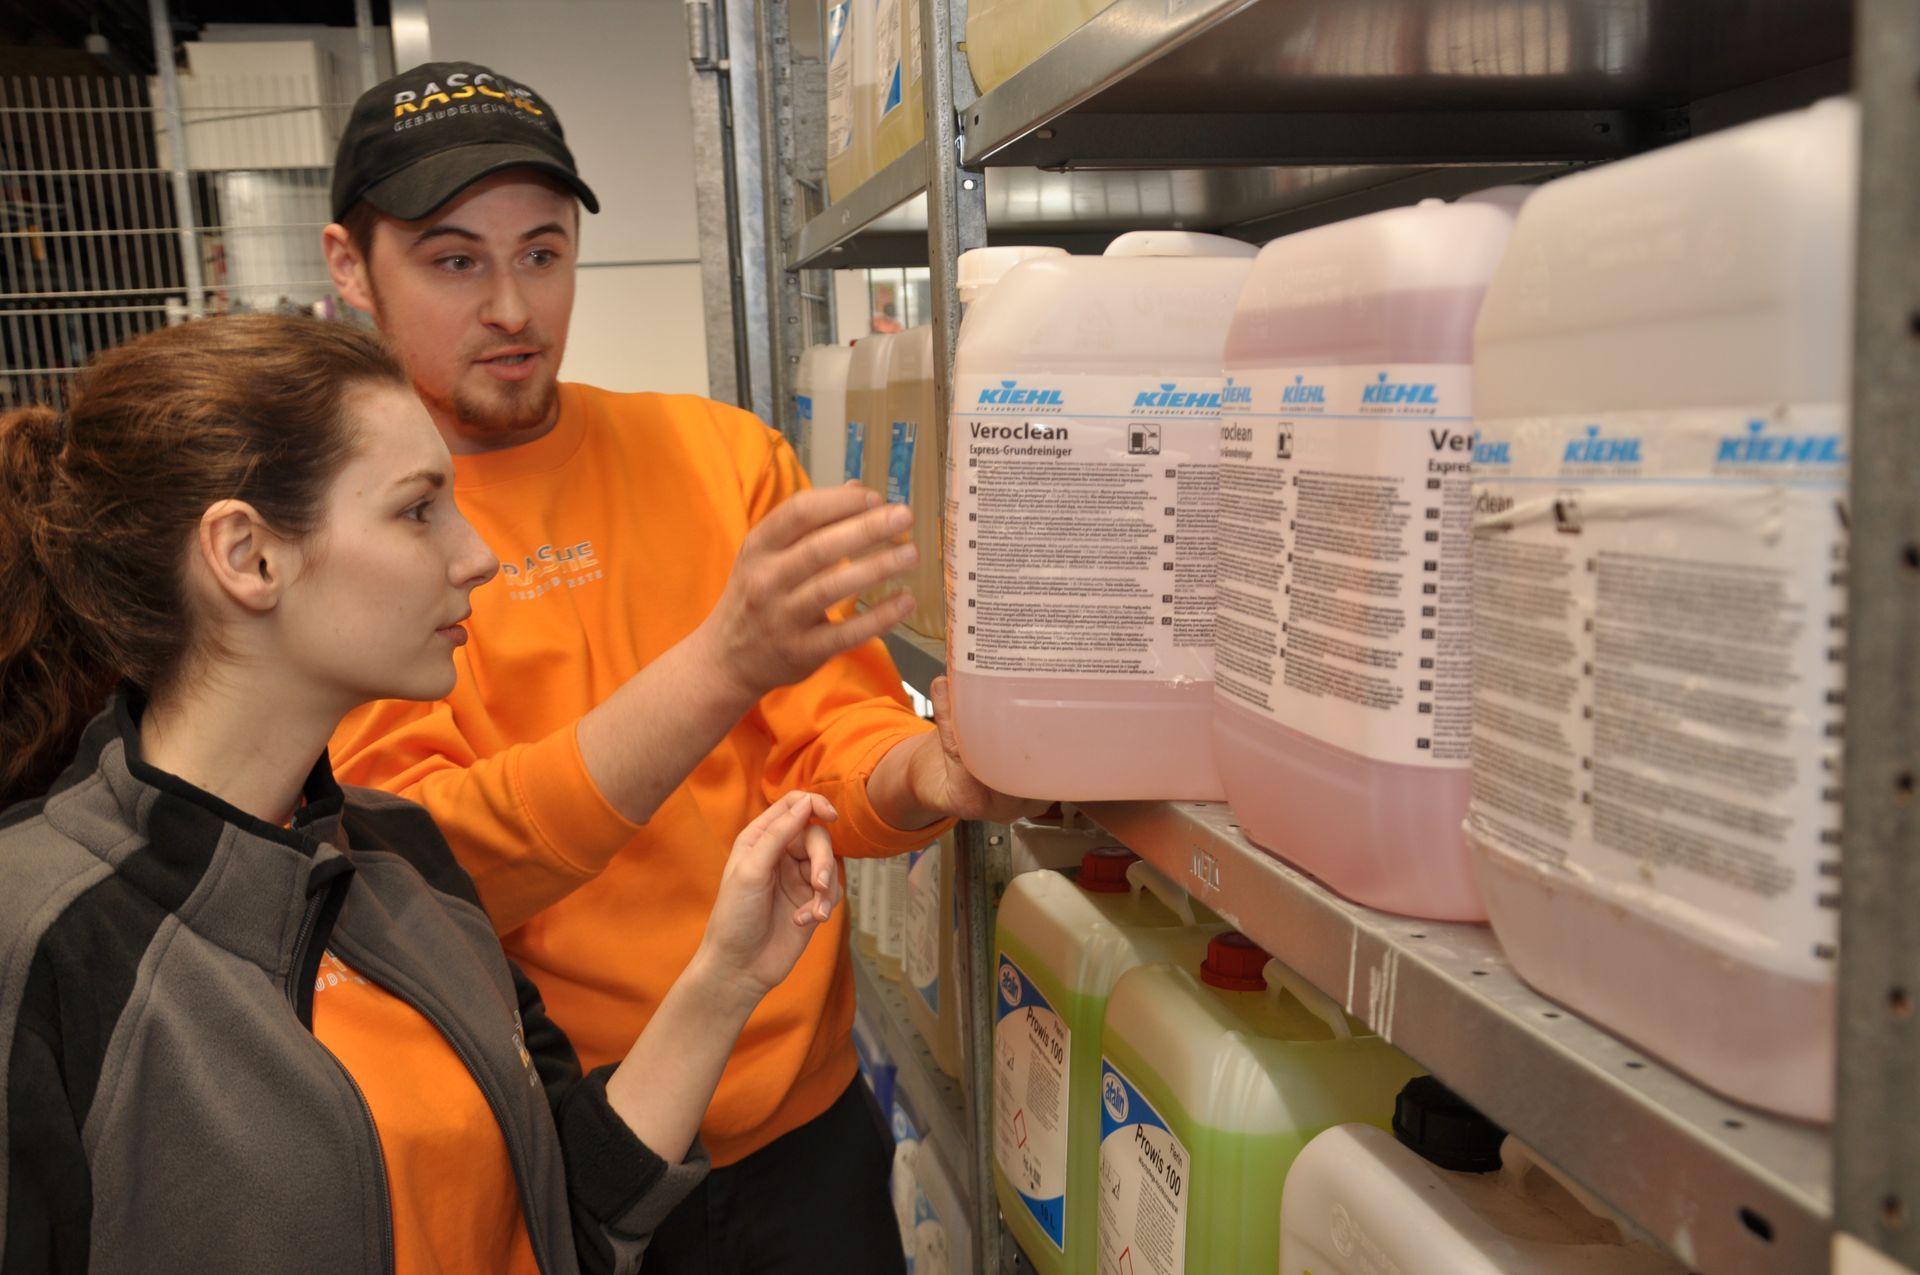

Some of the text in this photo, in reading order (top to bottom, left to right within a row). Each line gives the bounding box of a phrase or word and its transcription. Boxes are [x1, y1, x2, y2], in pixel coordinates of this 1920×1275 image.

[978, 380, 1064, 405] KIEHL
[1134, 383, 1222, 408] KIEHL
[1282, 375, 1325, 403] KIEHL
[1361, 373, 1439, 404] KIEHL
[970, 422, 1069, 440] Veroclean
[1564, 425, 1641, 463] KIEHL
[1717, 420, 1850, 462] KIEHL
[969, 444, 1073, 459] Express-Grundreiniger
[1027, 1005, 1050, 1047] Prowis
[1051, 1039, 1064, 1065] 100
[1135, 1123, 1164, 1175] Prowis
[1166, 1164, 1181, 1197] 100
